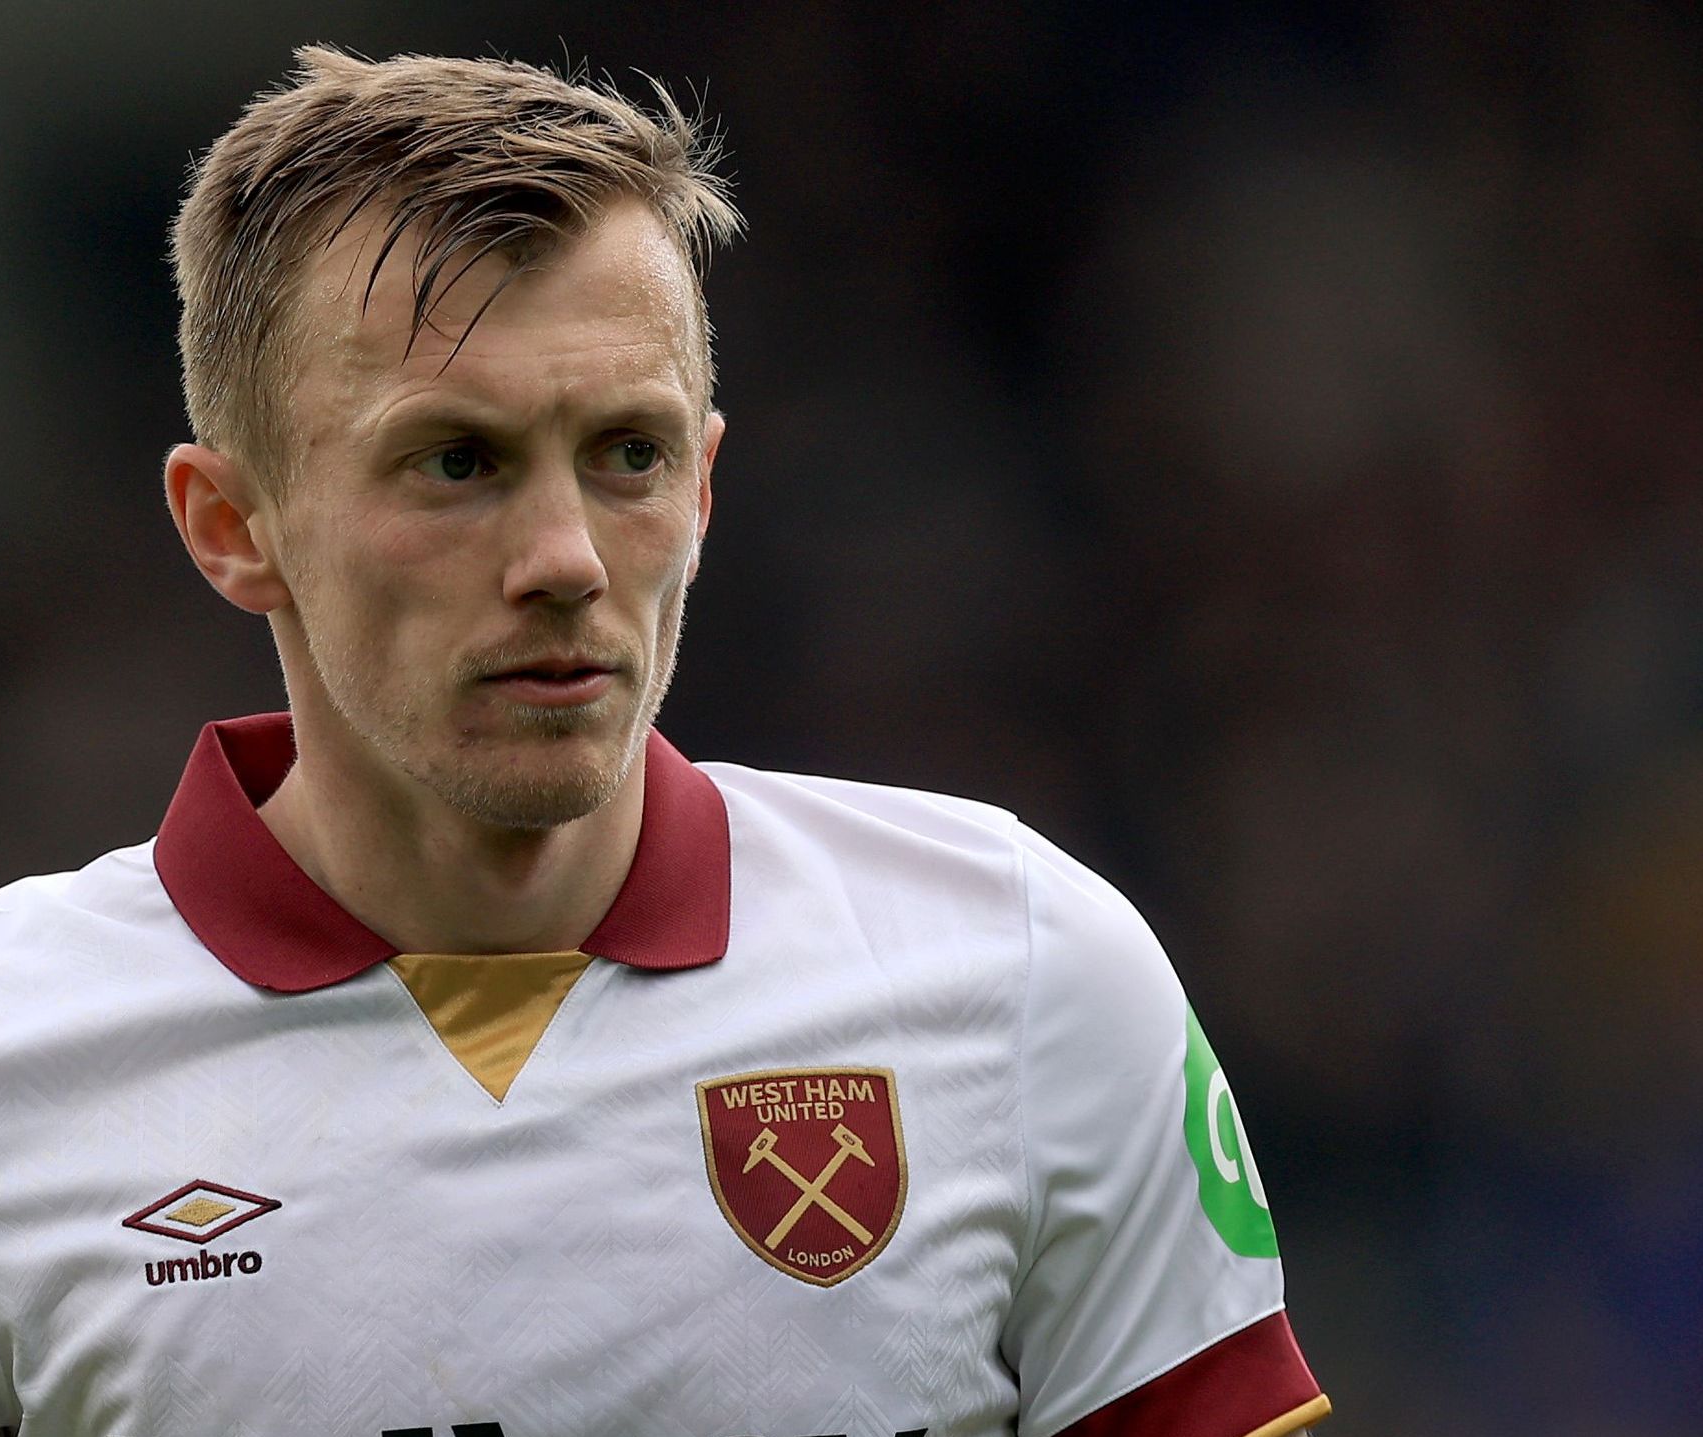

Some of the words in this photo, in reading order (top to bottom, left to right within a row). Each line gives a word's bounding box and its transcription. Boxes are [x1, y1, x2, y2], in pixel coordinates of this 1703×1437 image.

[721, 1080, 798, 1110] WEST
[804, 1078, 876, 1103] HAM
[757, 1101, 845, 1124] UNITED
[145, 1249, 263, 1286] umbro
[787, 1245, 856, 1268] LONDON
